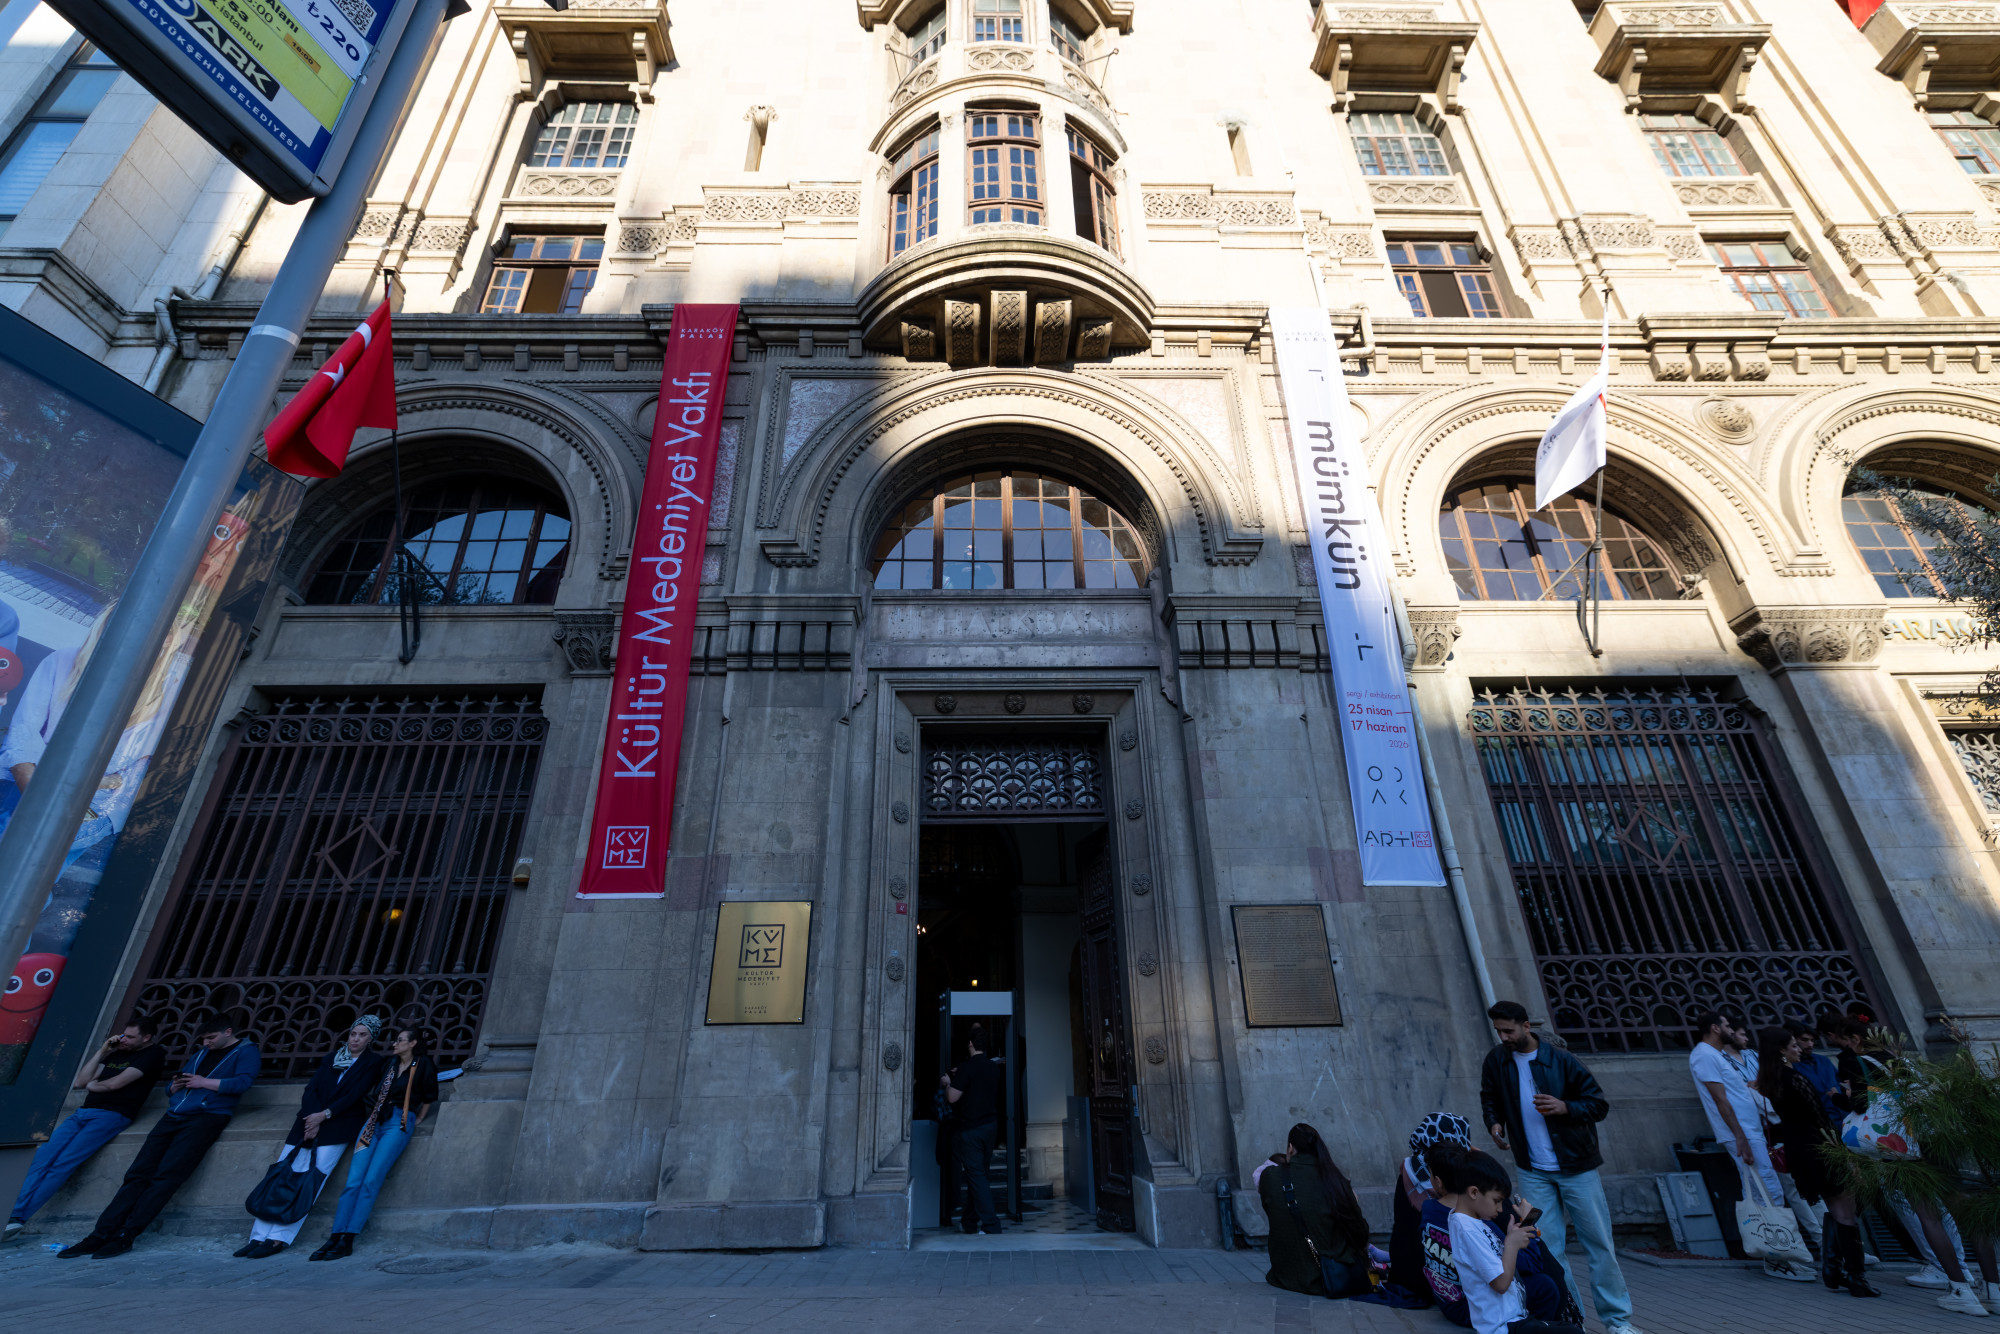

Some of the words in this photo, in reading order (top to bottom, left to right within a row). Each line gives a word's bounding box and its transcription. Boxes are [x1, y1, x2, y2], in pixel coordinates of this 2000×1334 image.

[247, 0, 274, 23] :00
[139, 0, 225, 82] BÜYÜKŞEHİR
[229, 84, 298, 151] BELEDİYESİ
[664, 371, 712, 447] Vakfı
[1306, 420, 1368, 590] mümkün
[631, 452, 704, 645] Medeniyet
[937, 609, 1136, 637] HALKBANK
[1346, 690, 1363, 699] sergi
[1369, 691, 1401, 700] exhibition
[613, 655, 668, 778] Kültür
[1348, 703, 1363, 714] 25
[1366, 705, 1393, 716] nisan
[1351, 720, 1363, 731] 17
[1366, 720, 1407, 734] haziran
[1389, 739, 1409, 749] 2026
